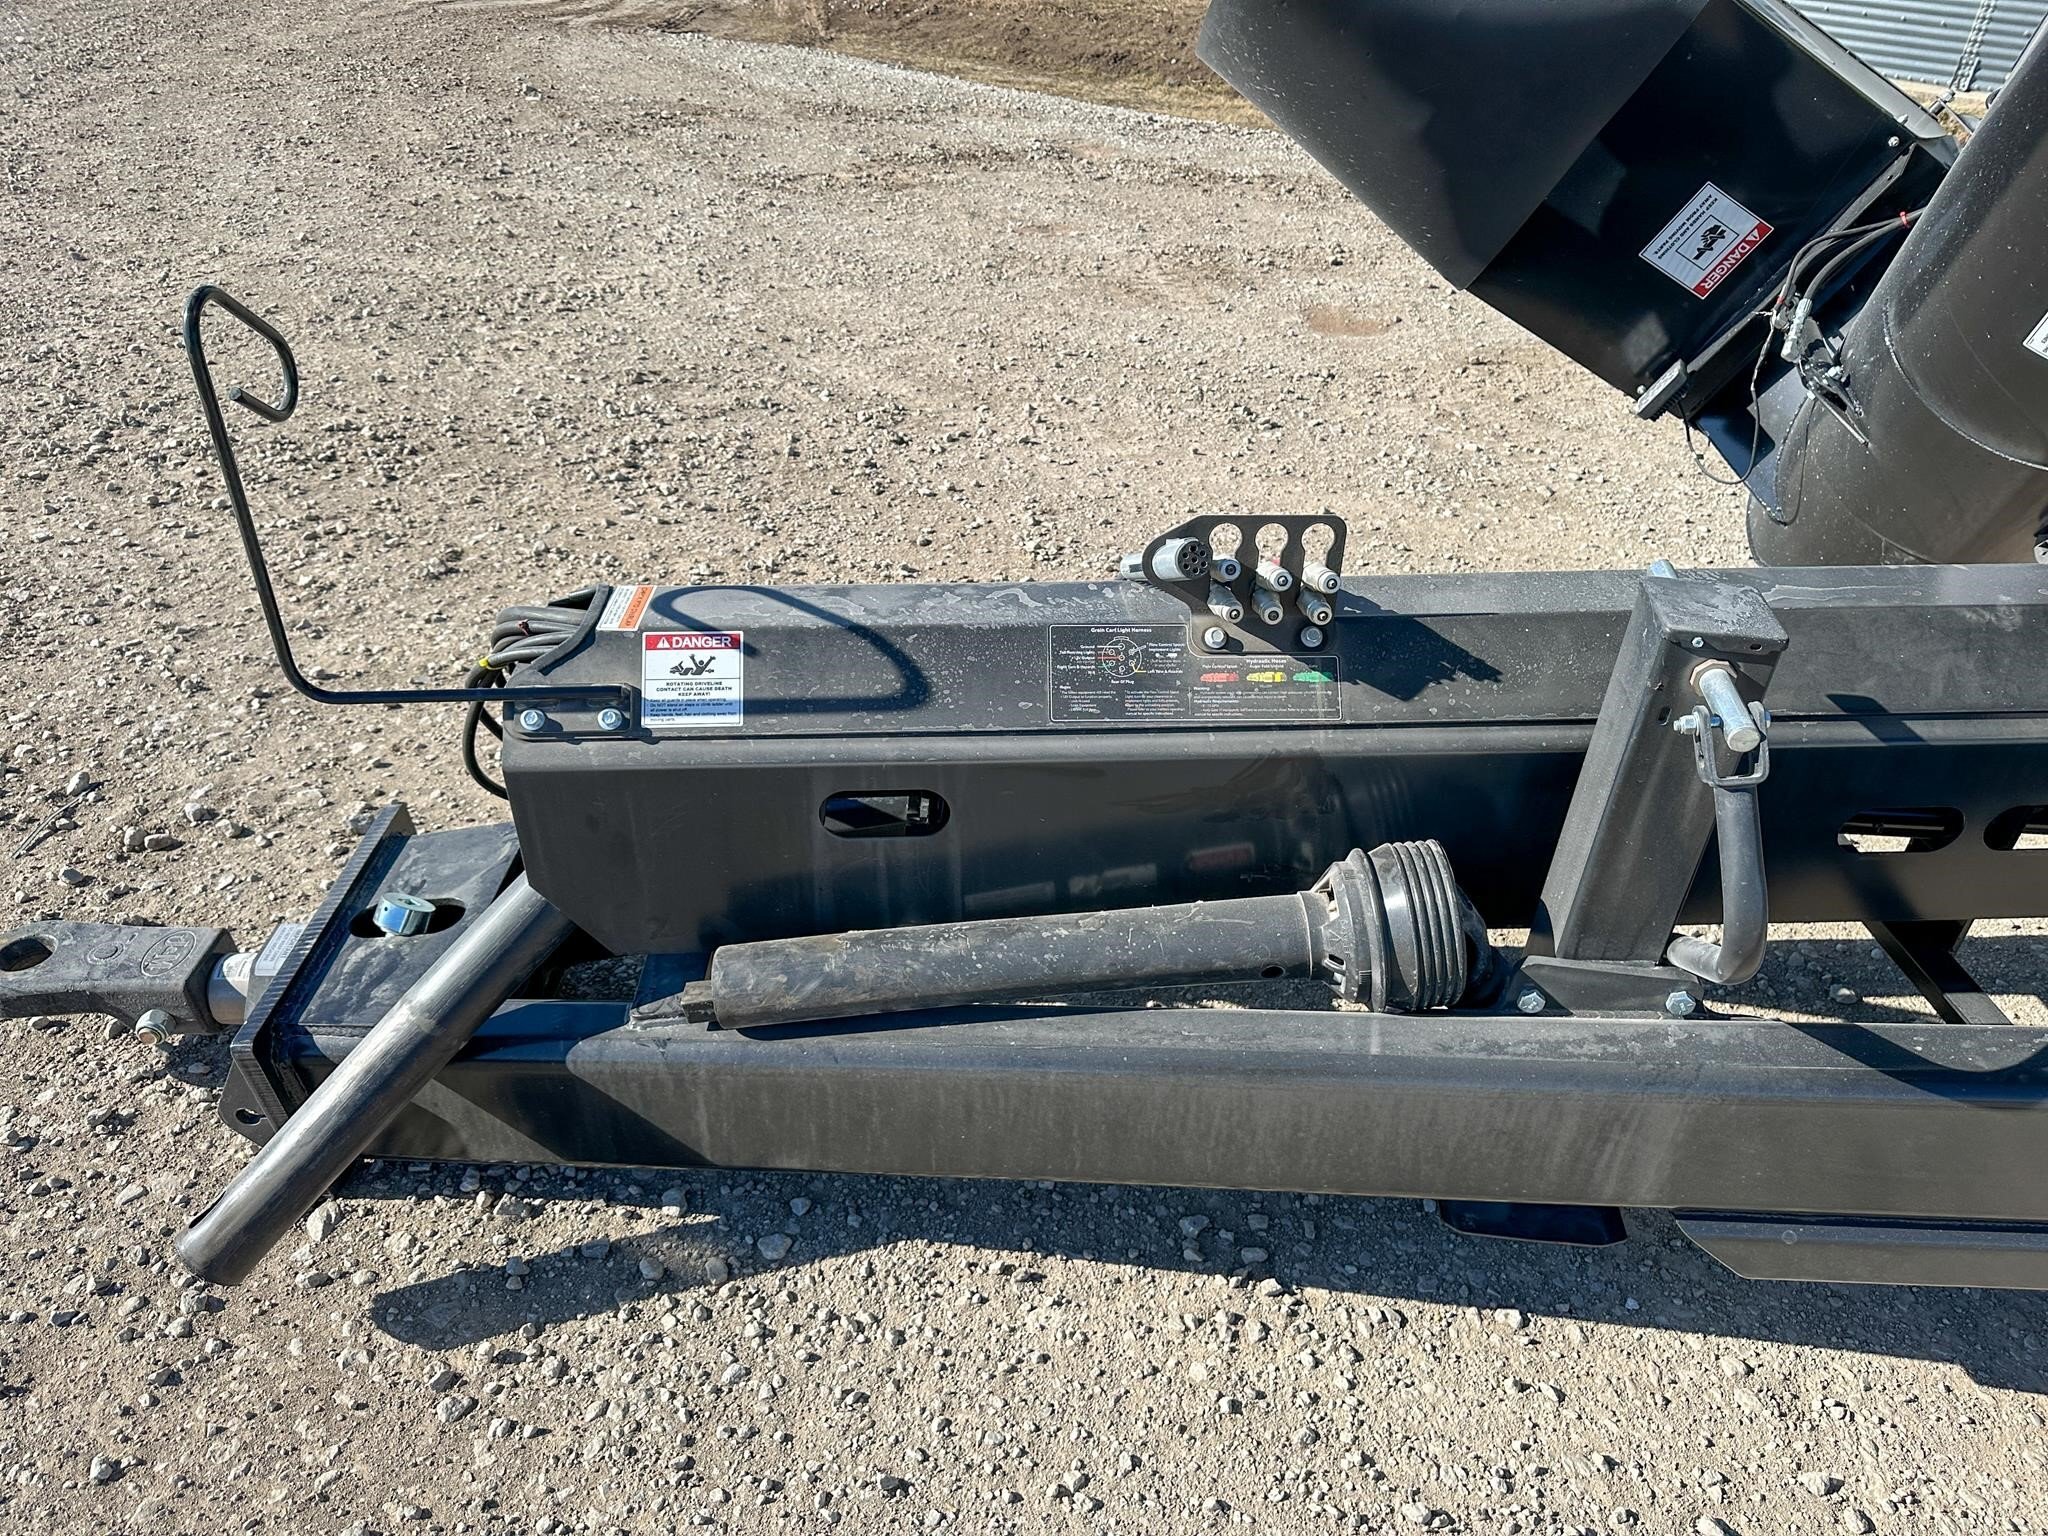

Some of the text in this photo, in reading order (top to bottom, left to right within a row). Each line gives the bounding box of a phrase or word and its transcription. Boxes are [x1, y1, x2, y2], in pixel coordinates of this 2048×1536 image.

[1705, 198, 1718, 211] KEEP
[1679, 226, 1690, 237] AND
[1700, 242, 1750, 289] DANGER
[672, 636, 732, 649] DANGER
